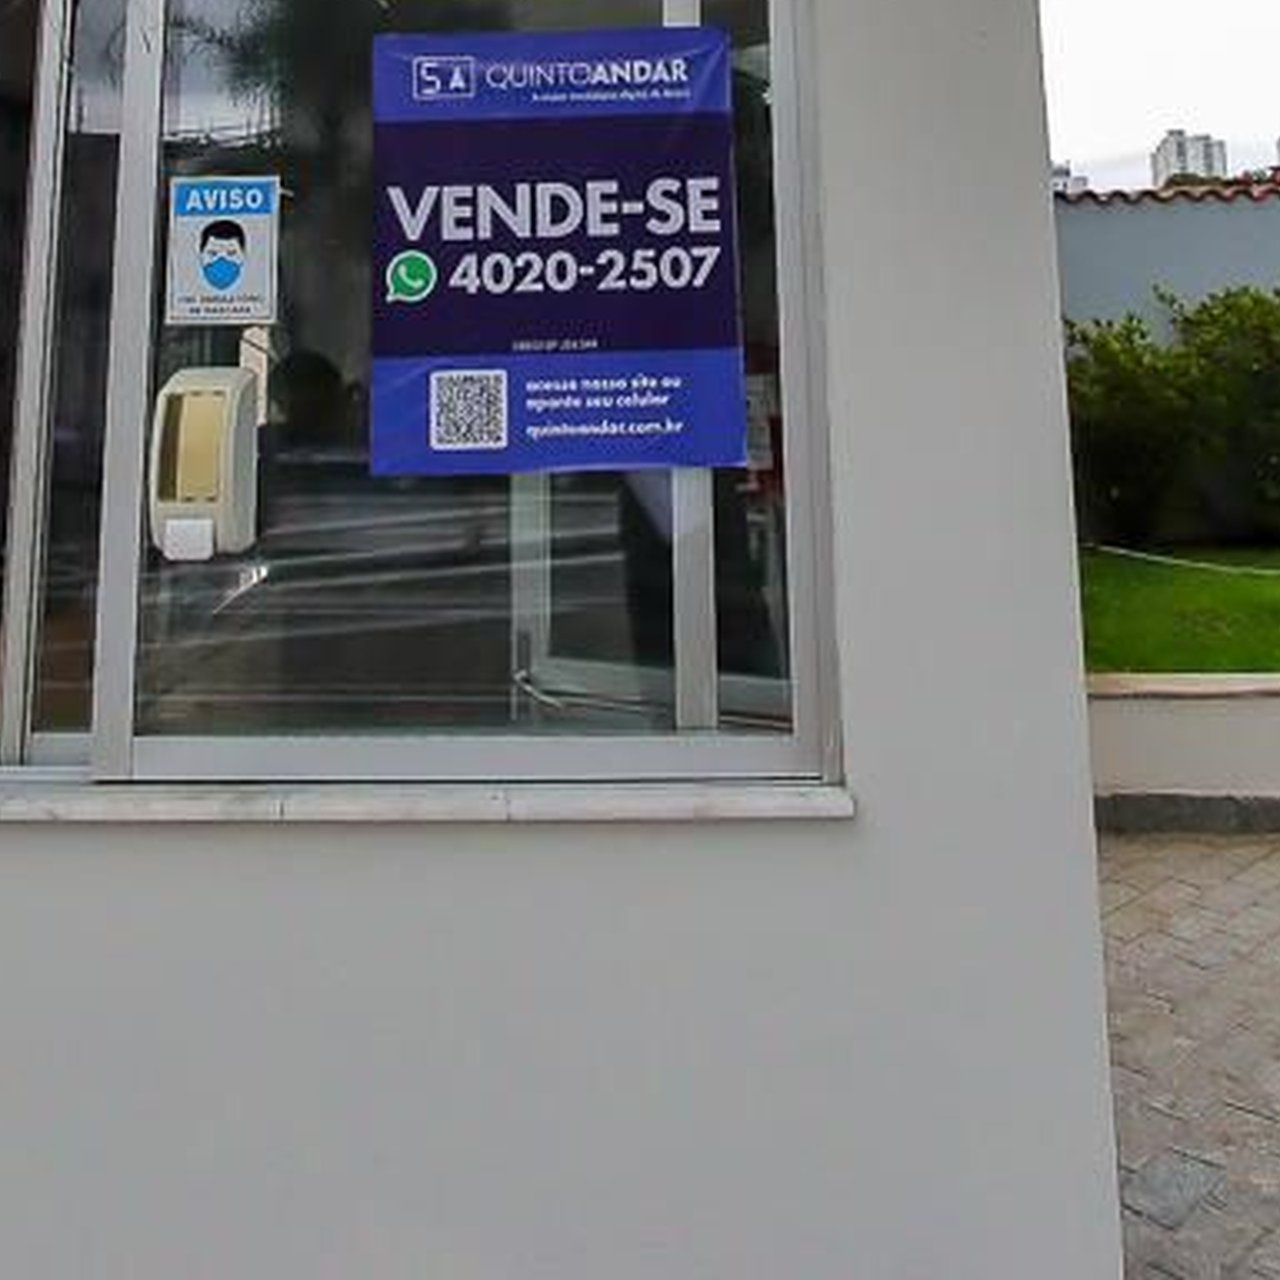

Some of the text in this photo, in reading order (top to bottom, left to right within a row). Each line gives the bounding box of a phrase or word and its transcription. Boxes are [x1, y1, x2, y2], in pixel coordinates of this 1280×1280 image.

[486, 58, 689, 90] QUINTOANDAR
[186, 188, 264, 212] AVISO
[386, 176, 721, 242] VENDE-SE
[448, 245, 721, 295] 4020-2507
